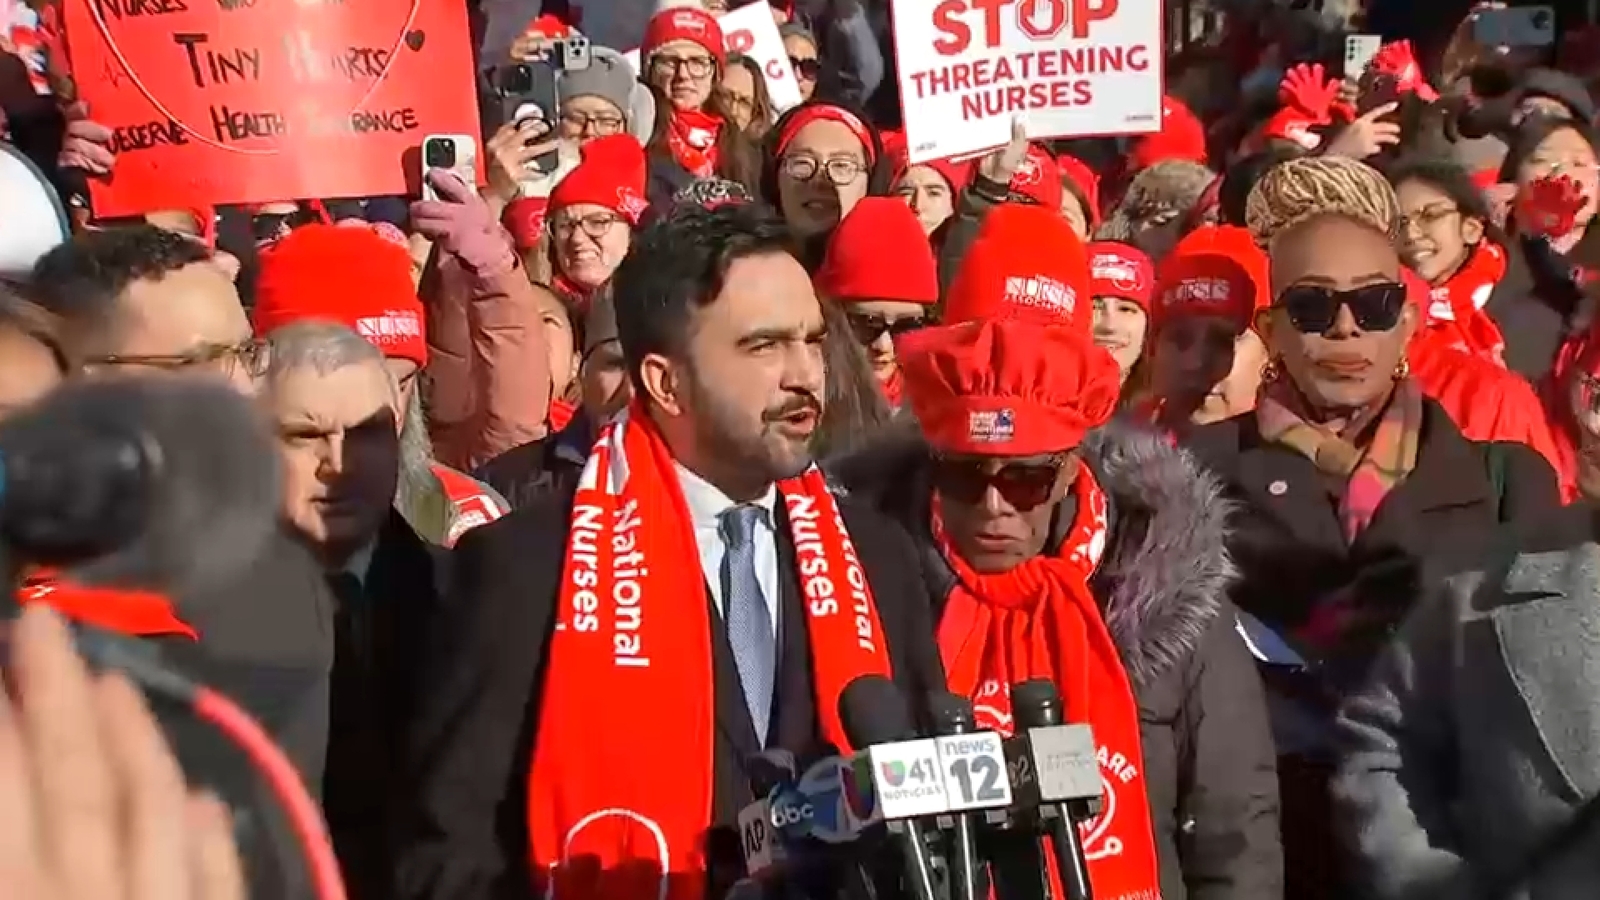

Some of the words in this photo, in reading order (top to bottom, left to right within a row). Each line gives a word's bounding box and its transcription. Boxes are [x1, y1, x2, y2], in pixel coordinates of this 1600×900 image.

[932, 0, 1119, 56] STOP
[174, 33, 260, 87] TINY
[910, 45, 1149, 98] THREATENING
[961, 80, 1092, 120] NURSES
[571, 504, 603, 633] Nurses
[785, 493, 838, 618] Nurses
[612, 499, 650, 668] National
[909, 757, 937, 784] 41
[945, 738, 995, 757] news
[1096, 745, 1138, 783] ARE
[950, 754, 1005, 804] 12
[744, 817, 765, 860] AP
